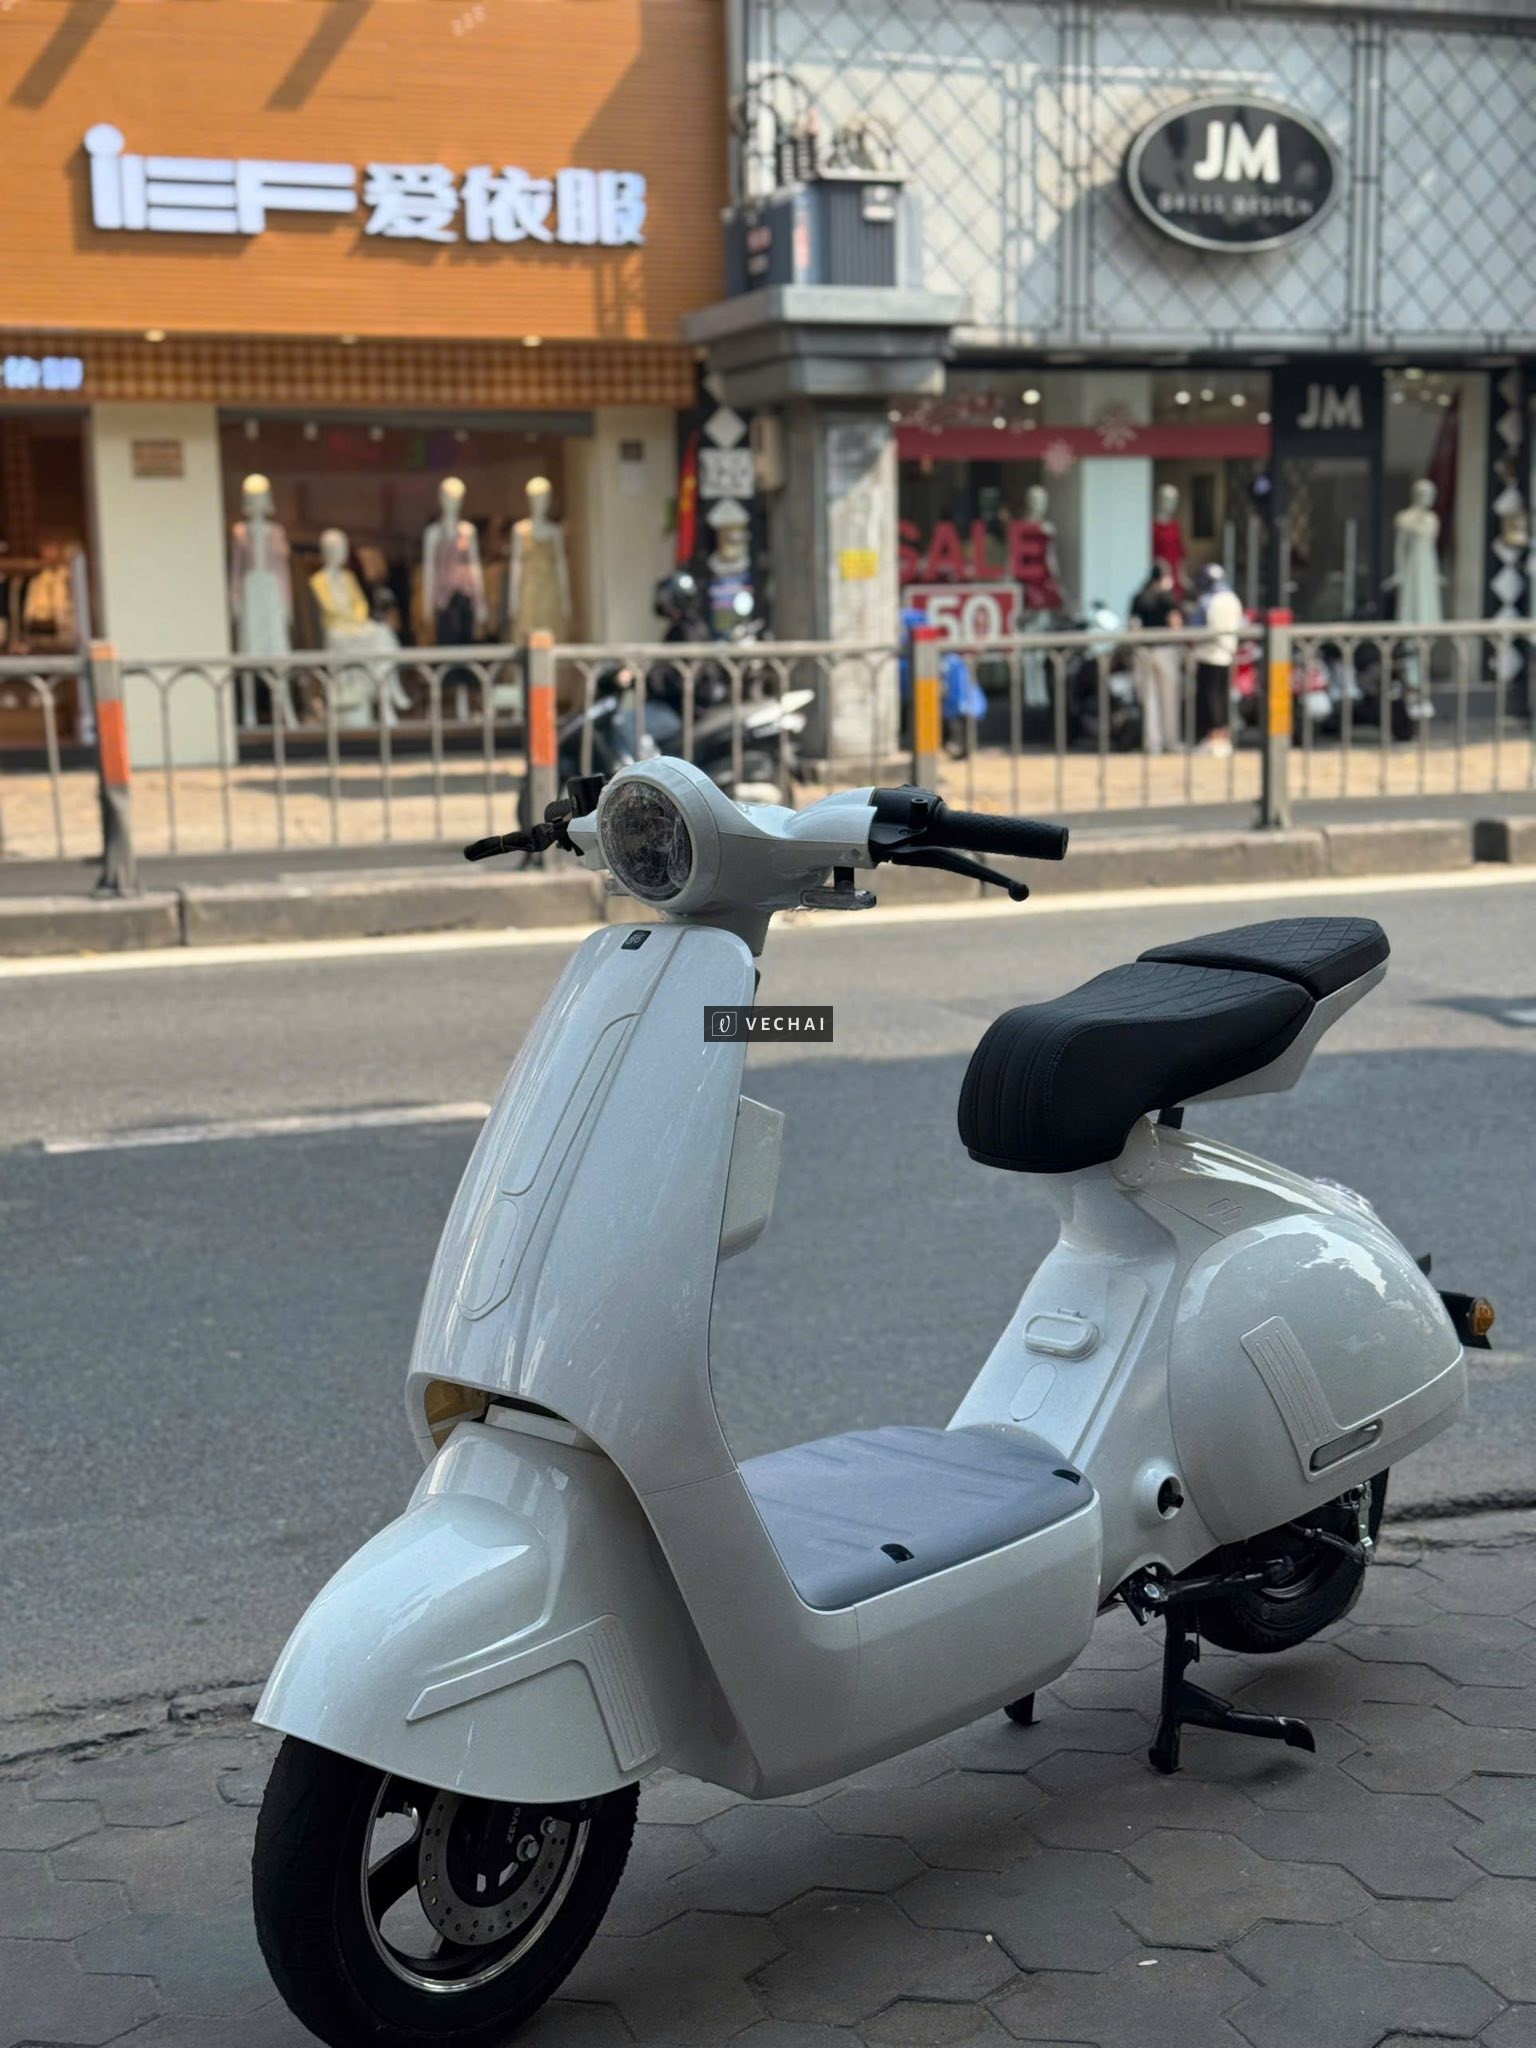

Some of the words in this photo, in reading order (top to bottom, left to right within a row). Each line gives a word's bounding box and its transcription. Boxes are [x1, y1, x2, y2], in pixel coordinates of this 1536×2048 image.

[1193, 120, 1281, 184] JM
[363, 162, 648, 246] 爱依服
[1296, 383, 1363, 430] JM
[899, 518, 1047, 583] SALE
